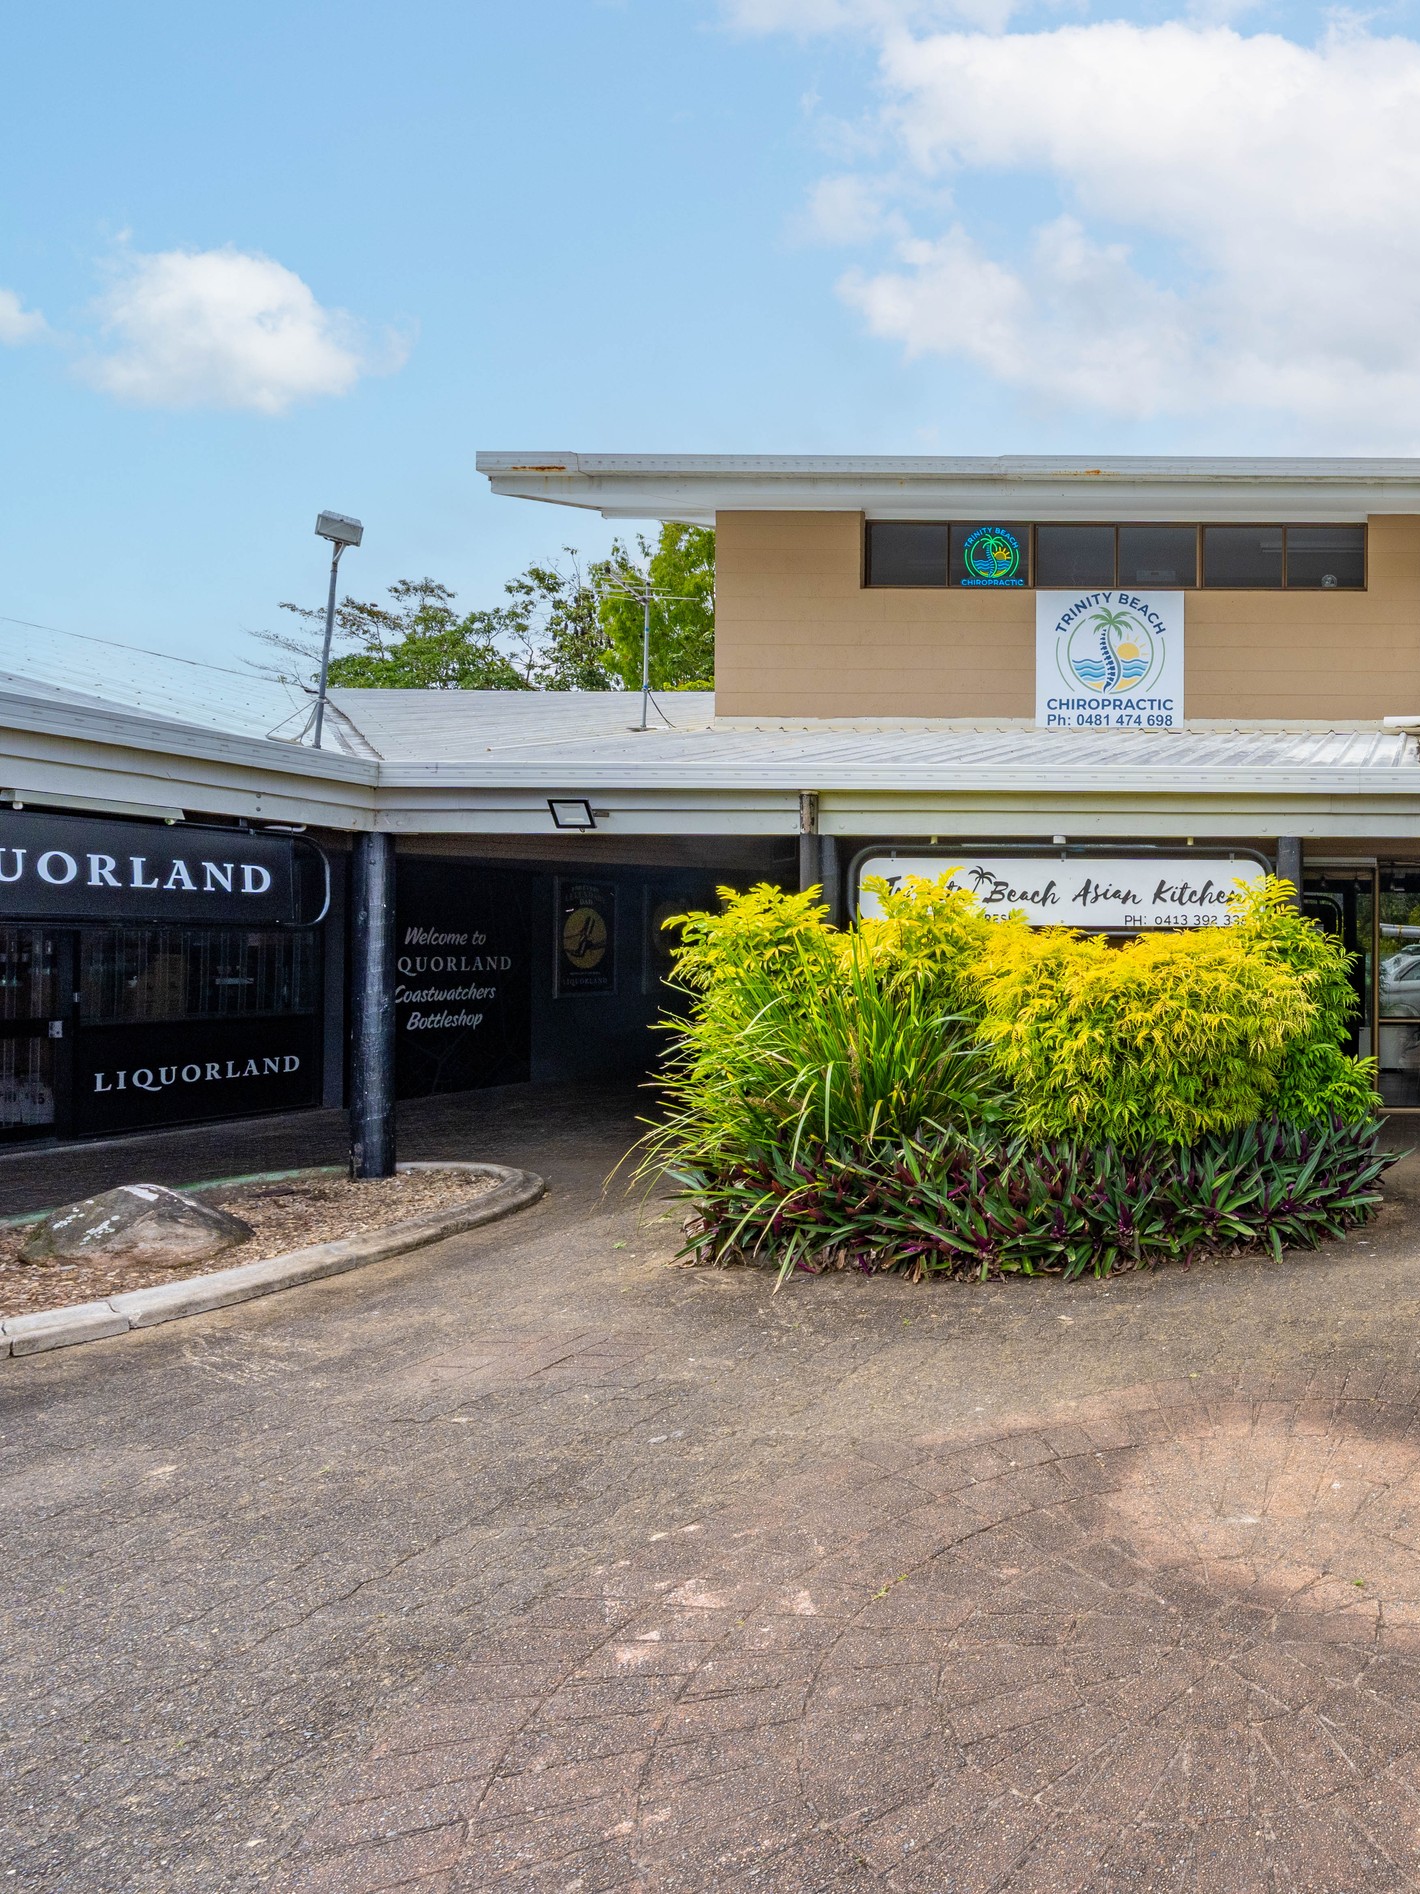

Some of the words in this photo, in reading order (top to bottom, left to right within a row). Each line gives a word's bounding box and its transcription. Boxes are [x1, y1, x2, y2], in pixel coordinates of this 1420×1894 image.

[964, 527, 993, 547] TRINITY
[994, 527, 1019, 549] BEACH
[1055, 592, 1112, 633] TRINITY
[1118, 593, 1166, 635] BEACH
[1046, 698, 1174, 711] CHIROPRACTIC
[1047, 714, 1071, 726] Ph:
[1076, 714, 1110, 726] 0481
[1115, 714, 1142, 726] 474
[1147, 714, 1173, 726] 698
[982, 880, 1060, 907] Beach
[1071, 878, 1143, 907] Asian
[1124, 914, 1147, 926] PH:
[1154, 914, 1188, 926] 0413
[1193, 914, 1218, 926] 392
[404, 926, 468, 945] Welcome
[471, 930, 487, 945] to
[395, 982, 497, 1004] Coastwatchers
[406, 1008, 483, 1031] Bottleshop
[93, 1055, 301, 1092] LIQUORLAND
